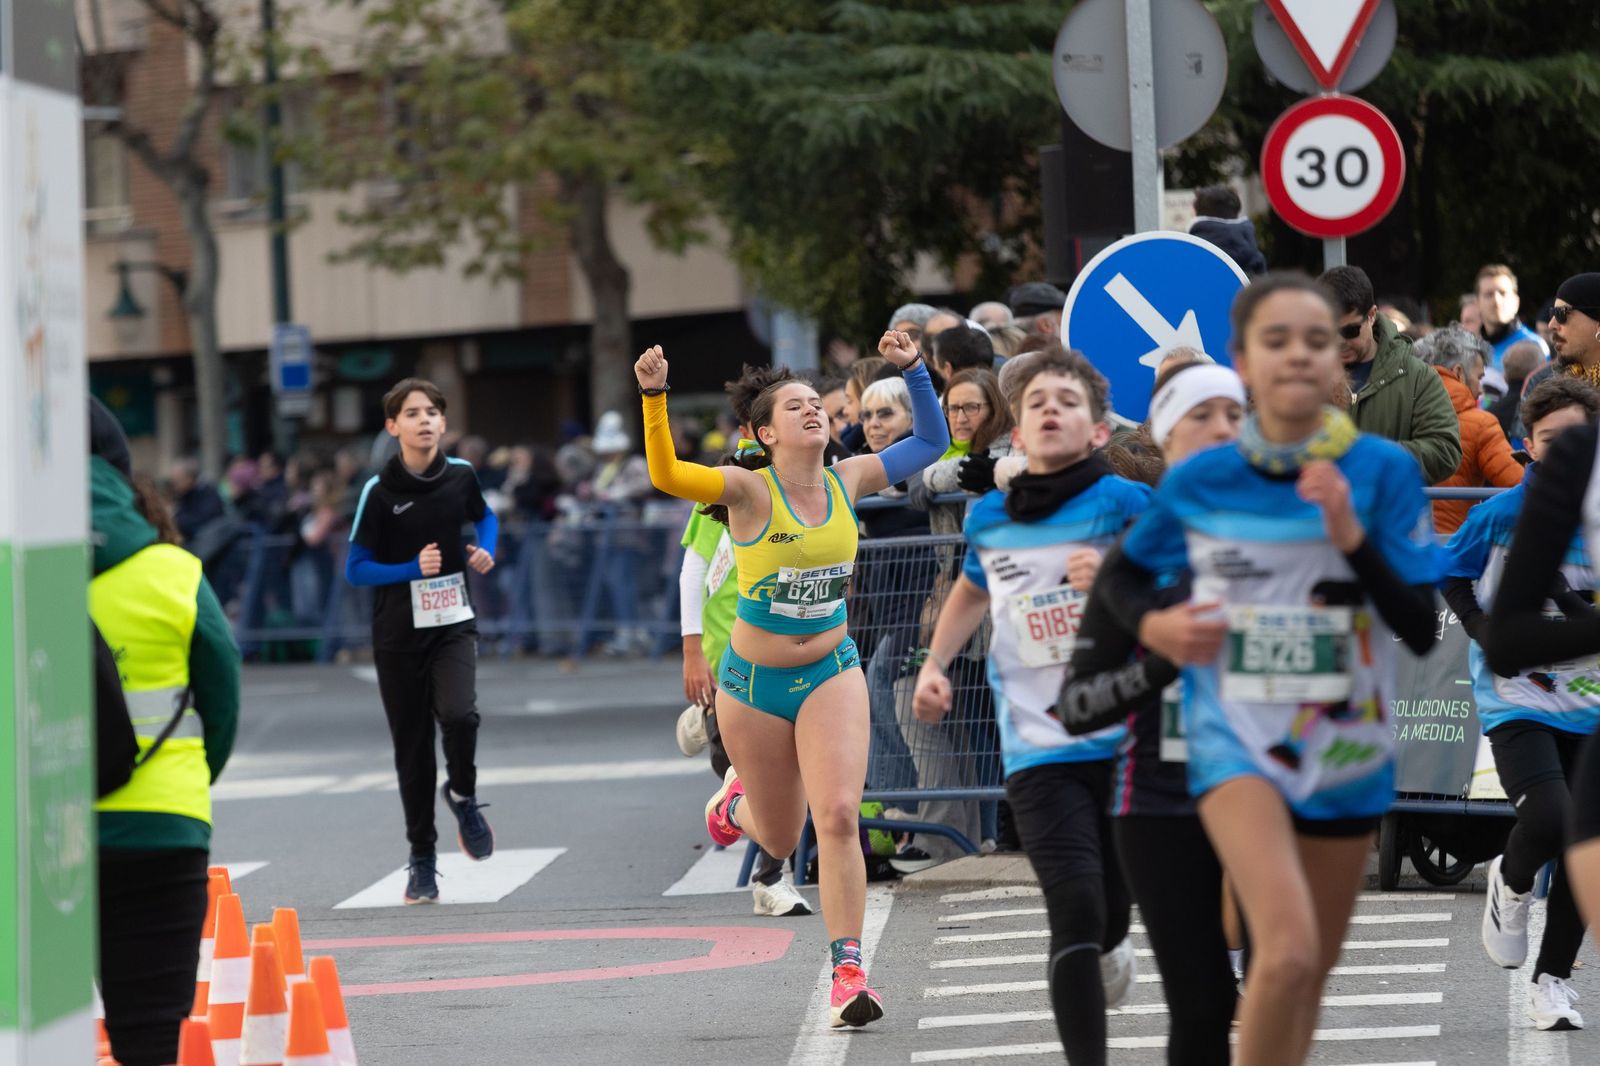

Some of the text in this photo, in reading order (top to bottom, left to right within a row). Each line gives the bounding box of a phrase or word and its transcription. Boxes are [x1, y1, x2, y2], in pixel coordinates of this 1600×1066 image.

[1295, 146, 1370, 190] 30
[801, 564, 847, 580] SETEL
[421, 587, 458, 611] 6289
[787, 579, 832, 602] 6210
[1032, 589, 1083, 608] SETE
[1026, 603, 1085, 641] 6185
[1391, 699, 1470, 719] SOLUCIONES
[1399, 723, 1408, 741] A
[1410, 723, 1465, 743] MEDIDA
